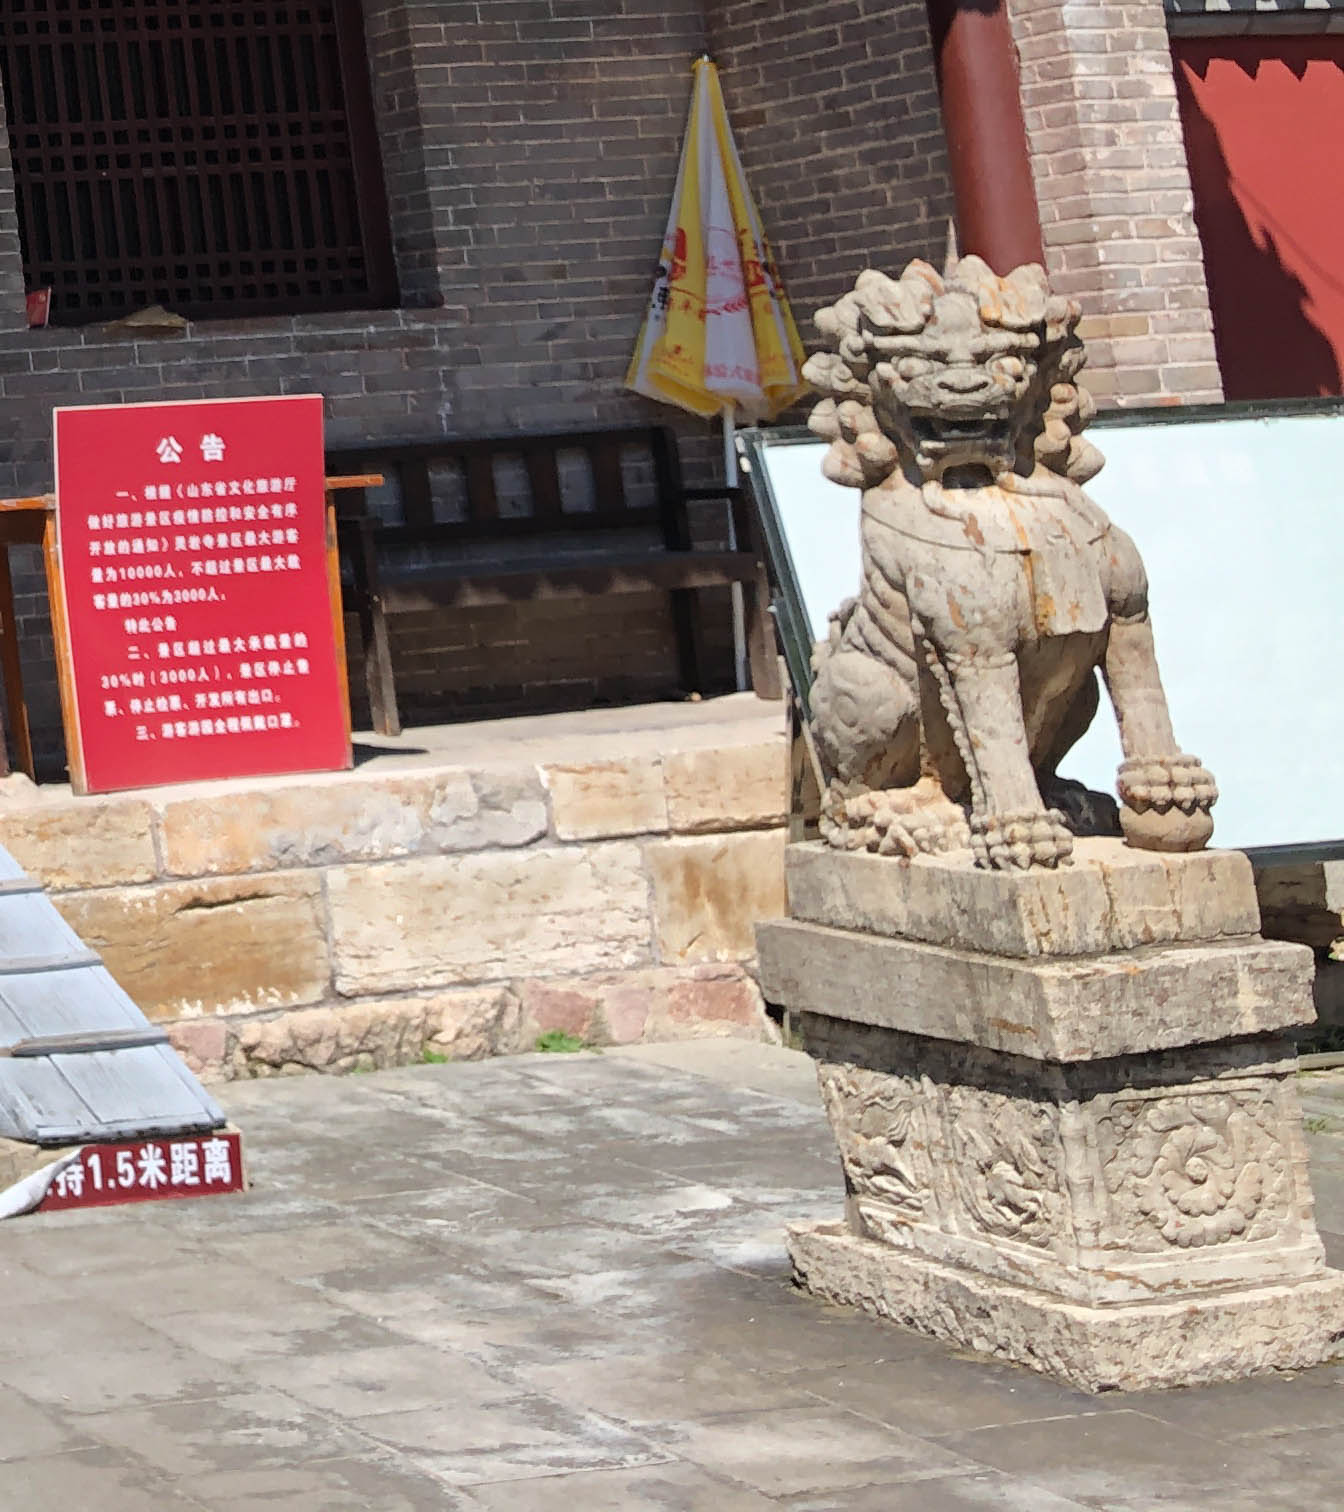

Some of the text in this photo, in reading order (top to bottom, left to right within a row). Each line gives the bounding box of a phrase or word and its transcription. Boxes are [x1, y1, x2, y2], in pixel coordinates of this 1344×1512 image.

[155, 432, 227, 465] 公告
[123, 615, 177, 635] 特此公告
[47, 1139, 232, 1198] 持1.5米距离
